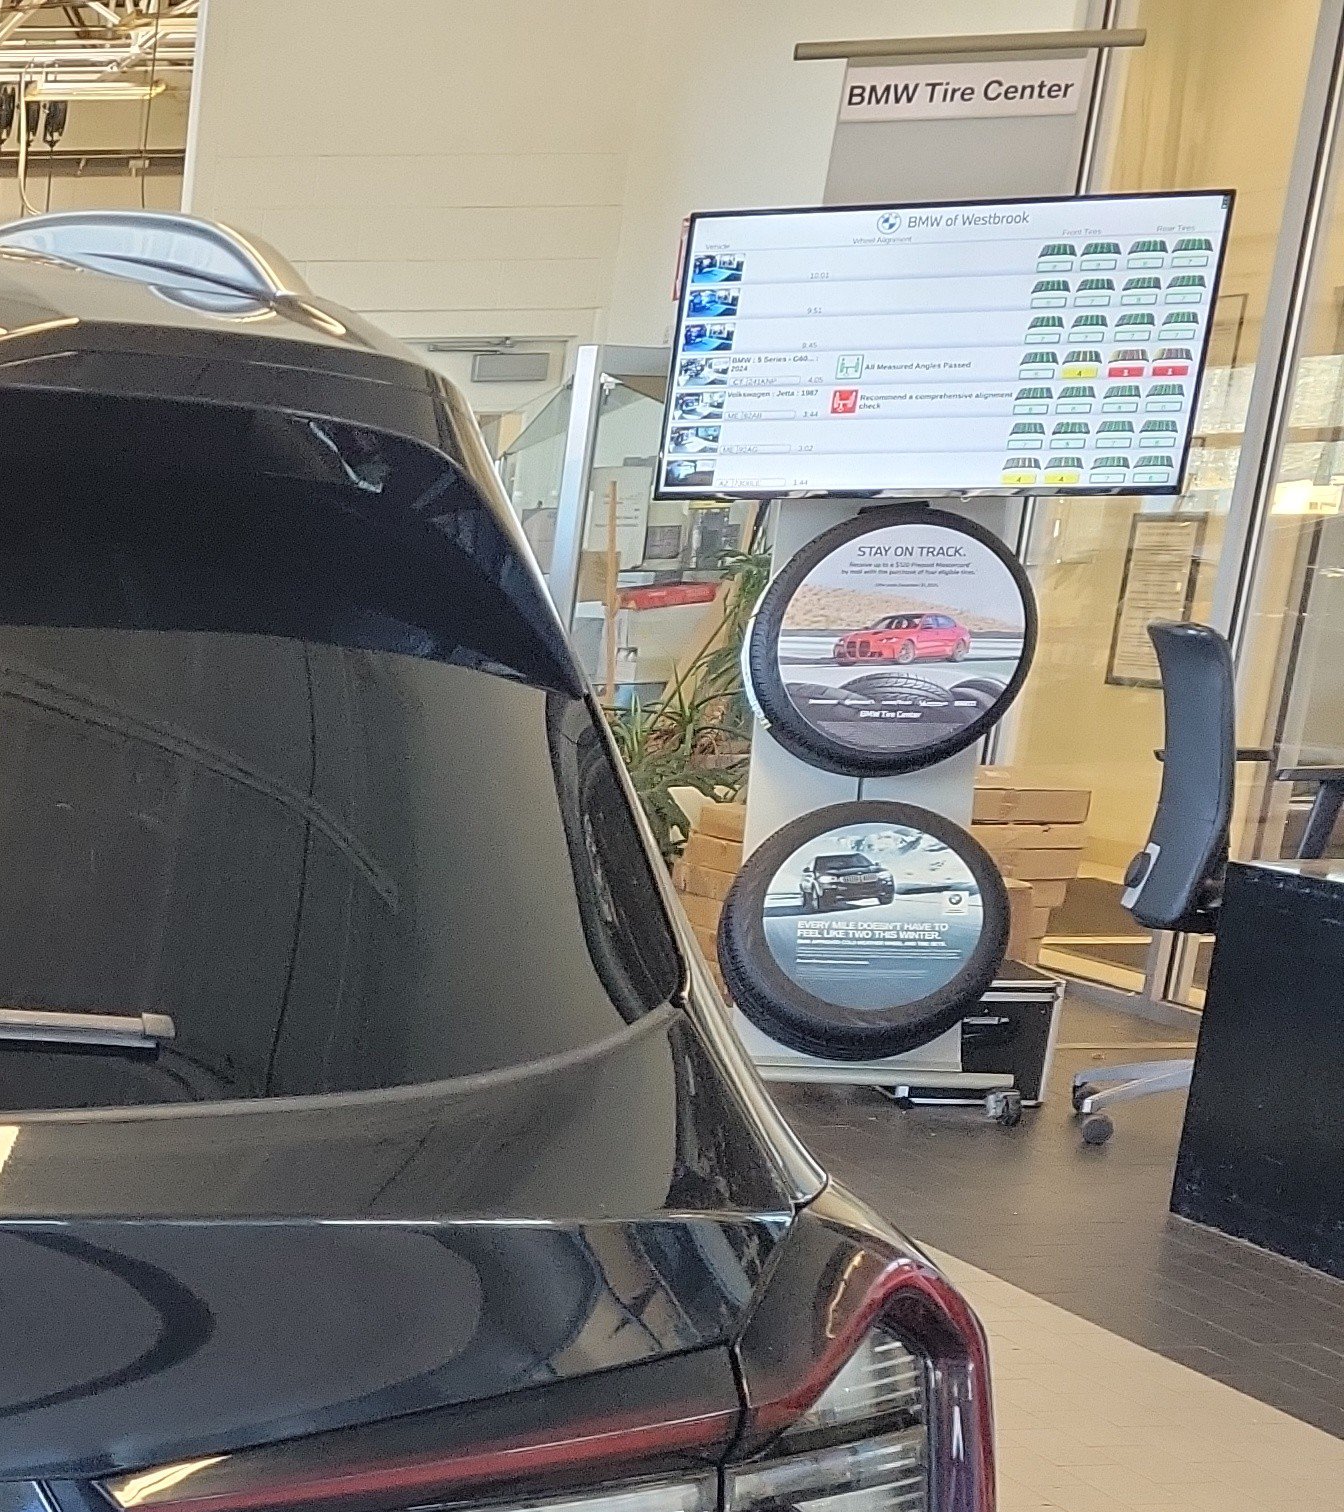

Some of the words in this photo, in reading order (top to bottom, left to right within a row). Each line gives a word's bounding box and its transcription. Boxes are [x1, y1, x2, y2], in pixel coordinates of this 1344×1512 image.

[847, 83, 919, 106] BMW
[924, 81, 975, 103] Tire
[983, 79, 1074, 101] Center
[908, 215, 942, 228] BMW
[945, 214, 958, 227] of
[962, 211, 1030, 226] Westbrook
[915, 362, 941, 371] Angles
[943, 361, 971, 369] Passed
[860, 393, 907, 401] Recommend
[915, 393, 973, 401] comprehensive
[975, 391, 1013, 399] alignment
[857, 546, 891, 557] STAY
[894, 546, 914, 557] ON
[917, 546, 967, 557] TRACK.
[797, 920, 831, 929] EVERY
[832, 921, 856, 930] MILE
[904, 922, 933, 931] HAVE
[934, 923, 949, 931] TO
[797, 929, 822, 937] FEEL
[824, 930, 846, 938] LIKE
[848, 930, 872, 939] TWO
[874, 931, 898, 939] THIS
[899, 931, 941, 940] WINTER.
